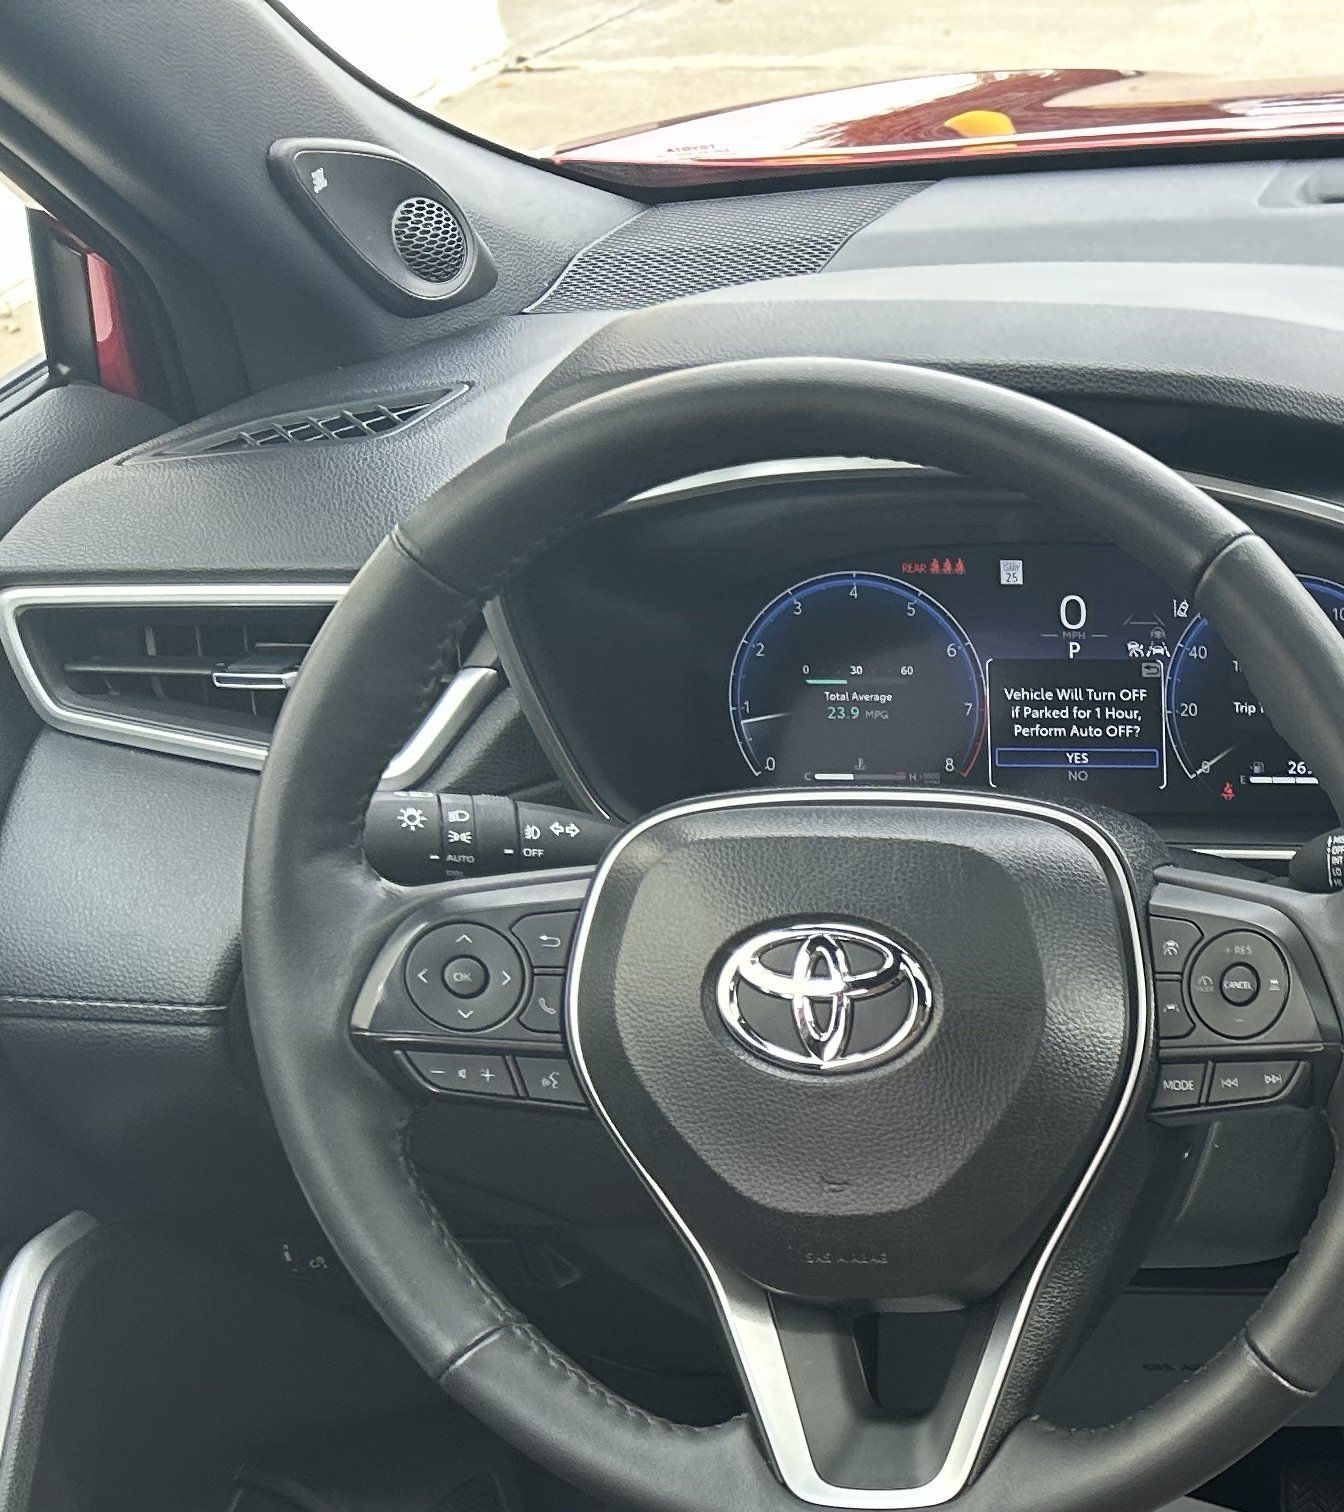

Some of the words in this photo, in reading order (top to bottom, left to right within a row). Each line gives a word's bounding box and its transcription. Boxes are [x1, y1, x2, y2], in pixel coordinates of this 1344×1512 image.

[849, 584, 858, 599] 4
[793, 601, 802, 616] 3
[906, 602, 916, 617] 5
[1059, 594, 1087, 630] 0
[1062, 630, 1086, 640] MPH
[756, 643, 765, 657] 2
[946, 643, 957, 658] 6
[1069, 642, 1081, 659] P
[1188, 646, 1208, 660] 40
[802, 665, 810, 676] 0
[850, 665, 863, 676] 30
[900, 665, 914, 676] 60
[824, 691, 850, 702] Total
[851, 691, 893, 703] Average
[1004, 688, 1054, 701] Vehicle
[1056, 688, 1084, 701] Will
[1086, 689, 1116, 701] Turn
[1119, 689, 1148, 701] OFF
[743, 700, 750, 714] 1
[827, 706, 860, 720] 23.9
[865, 709, 889, 720] MPG
[964, 703, 973, 716] 7
[1011, 706, 1022, 719] if
[1023, 706, 1071, 719] Parked
[1072, 706, 1093, 719] for
[1095, 707, 1101, 719] 1
[1105, 707, 1142, 721] Hour,
[1180, 702, 1198, 717] 20
[1233, 701, 1256, 715] Trip
[1014, 724, 1067, 738] Perform
[1069, 725, 1103, 738] Auto
[1106, 725, 1141, 738] OFF?
[766, 756, 776, 771] 0
[945, 757, 955, 772] 8
[1065, 752, 1089, 764] YES
[1067, 770, 1089, 782] NO
[446, 853, 475, 865] AUTO
[522, 848, 544, 859] OFF
[1223, 981, 1252, 990] CANCEL
[1163, 1080, 1195, 1091] MODE
